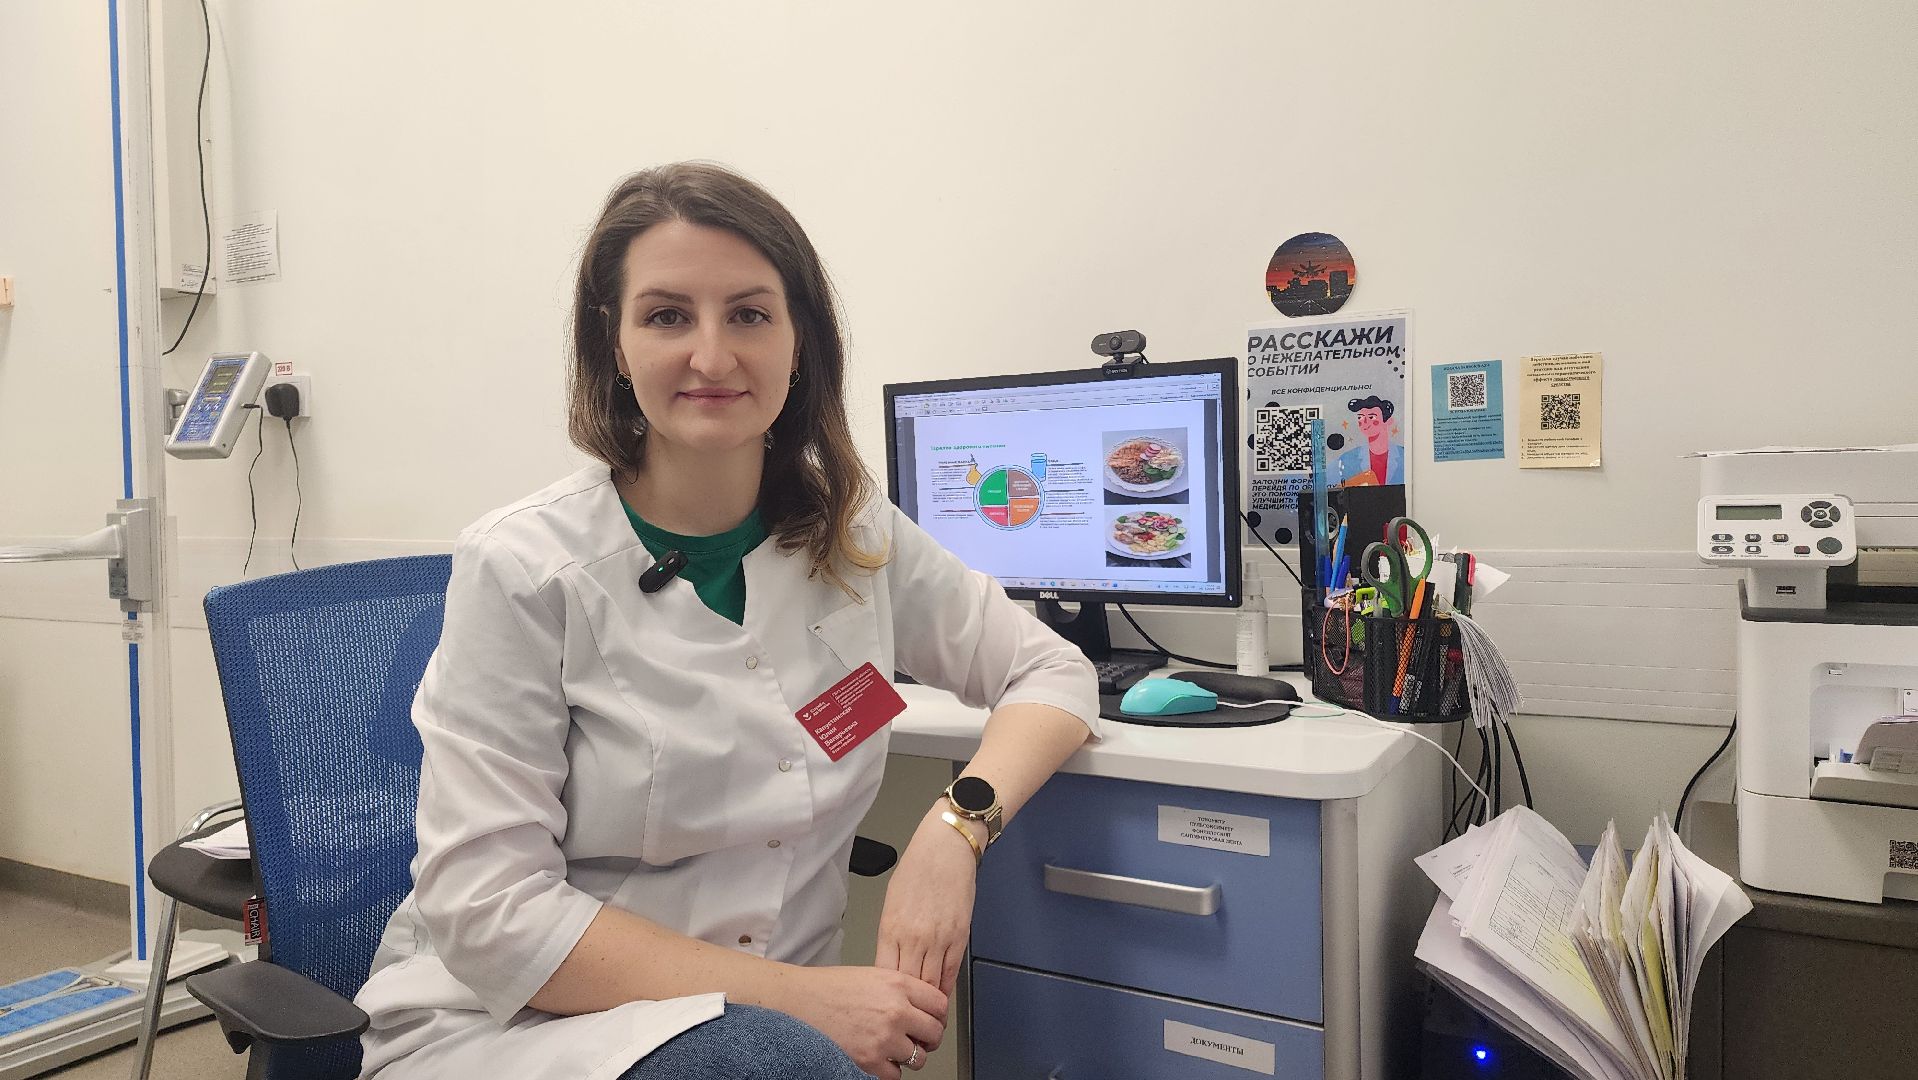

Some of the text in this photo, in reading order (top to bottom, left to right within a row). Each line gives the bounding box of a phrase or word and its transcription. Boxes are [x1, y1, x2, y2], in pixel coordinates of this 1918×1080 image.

[1247, 325, 1395, 352] РАССКАЖИ
[1247, 345, 1400, 366] О НЕЖЕЛАТЕЛЬНОМ
[1247, 363, 1320, 378] СОБЫТИИ
[1287, 384, 1372, 395] КОНФИДЕНЦИАЛЬНО!
[1039, 591, 1060, 600] DELL
[819, 726, 838, 741] Юлия
[824, 720, 859, 747] Валерьевна
[1180, 832, 1225, 843] САНТИМЕТРОВАЯ
[1190, 1036, 1244, 1056] ДОКУМЕНТЫ
